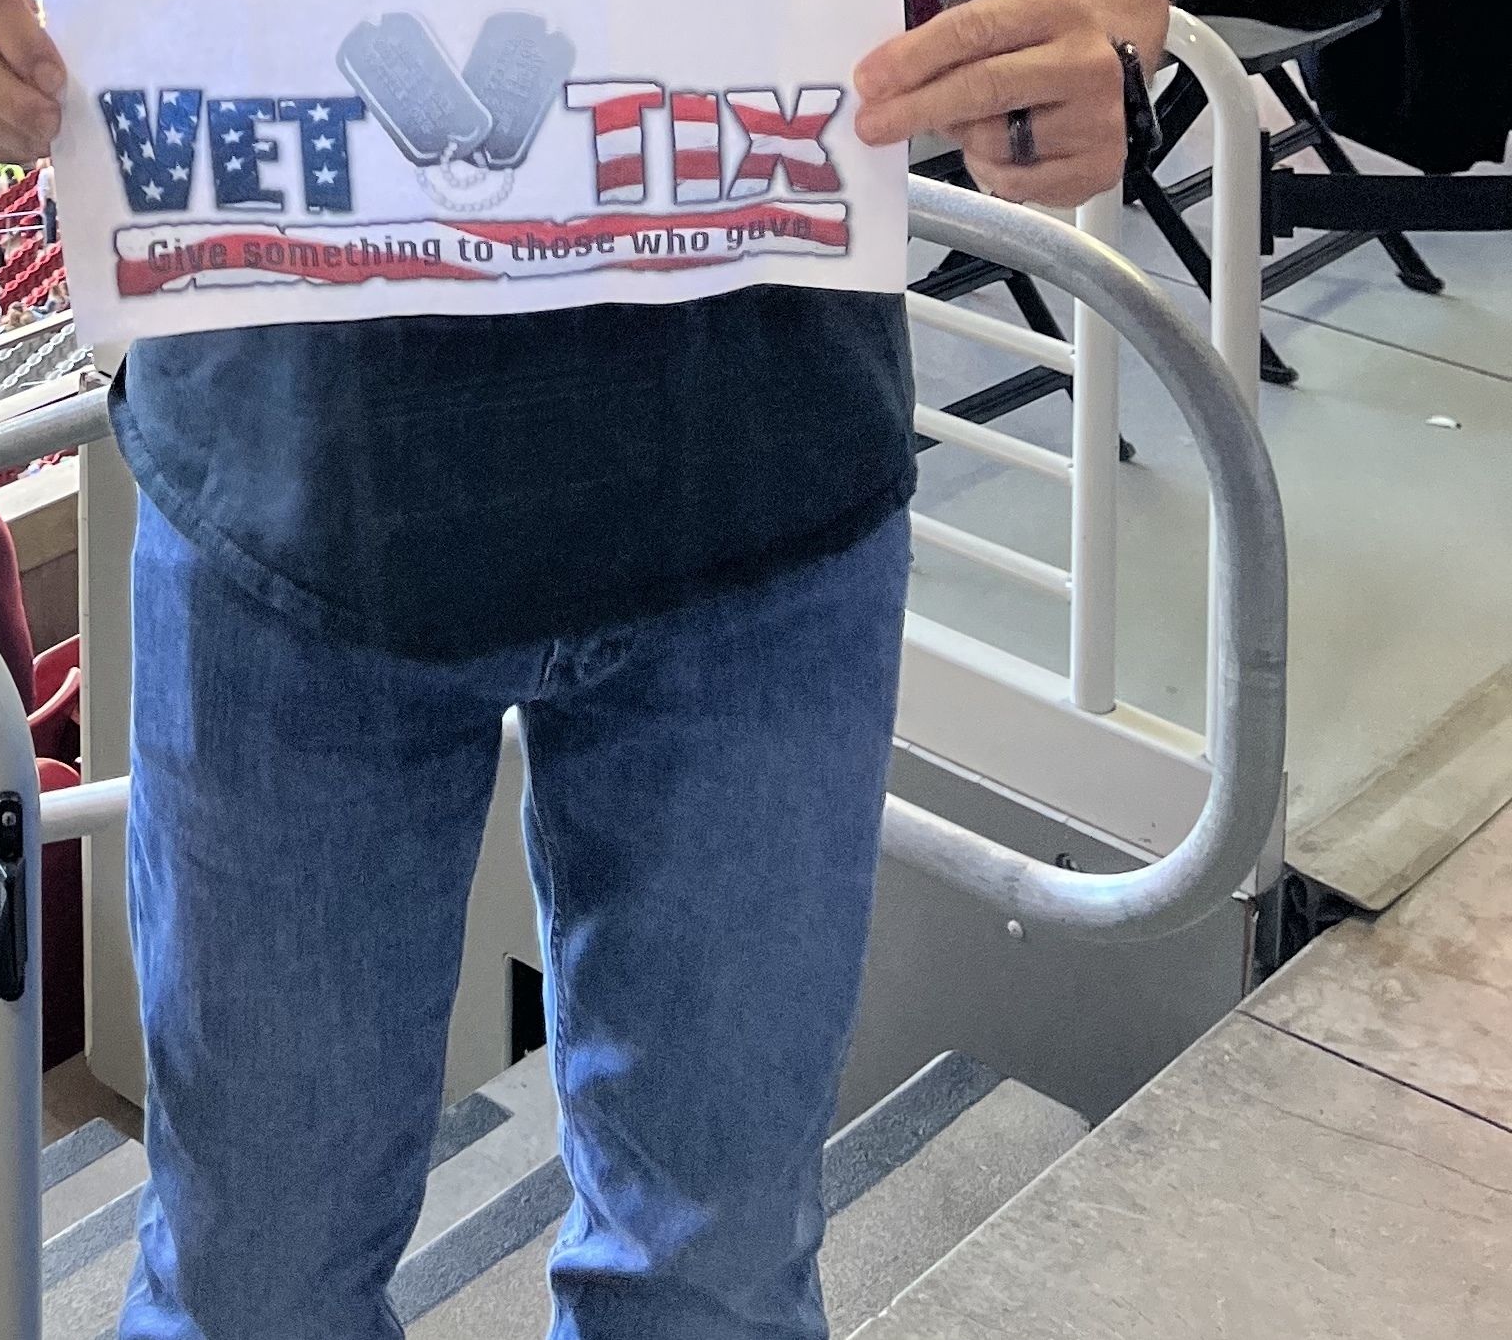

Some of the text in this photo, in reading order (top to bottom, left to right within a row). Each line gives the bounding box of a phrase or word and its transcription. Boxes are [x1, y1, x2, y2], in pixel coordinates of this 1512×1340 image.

[100, 88, 368, 215] VET
[565, 79, 846, 206] TIX
[148, 213, 814, 275] Give something to those who gave
